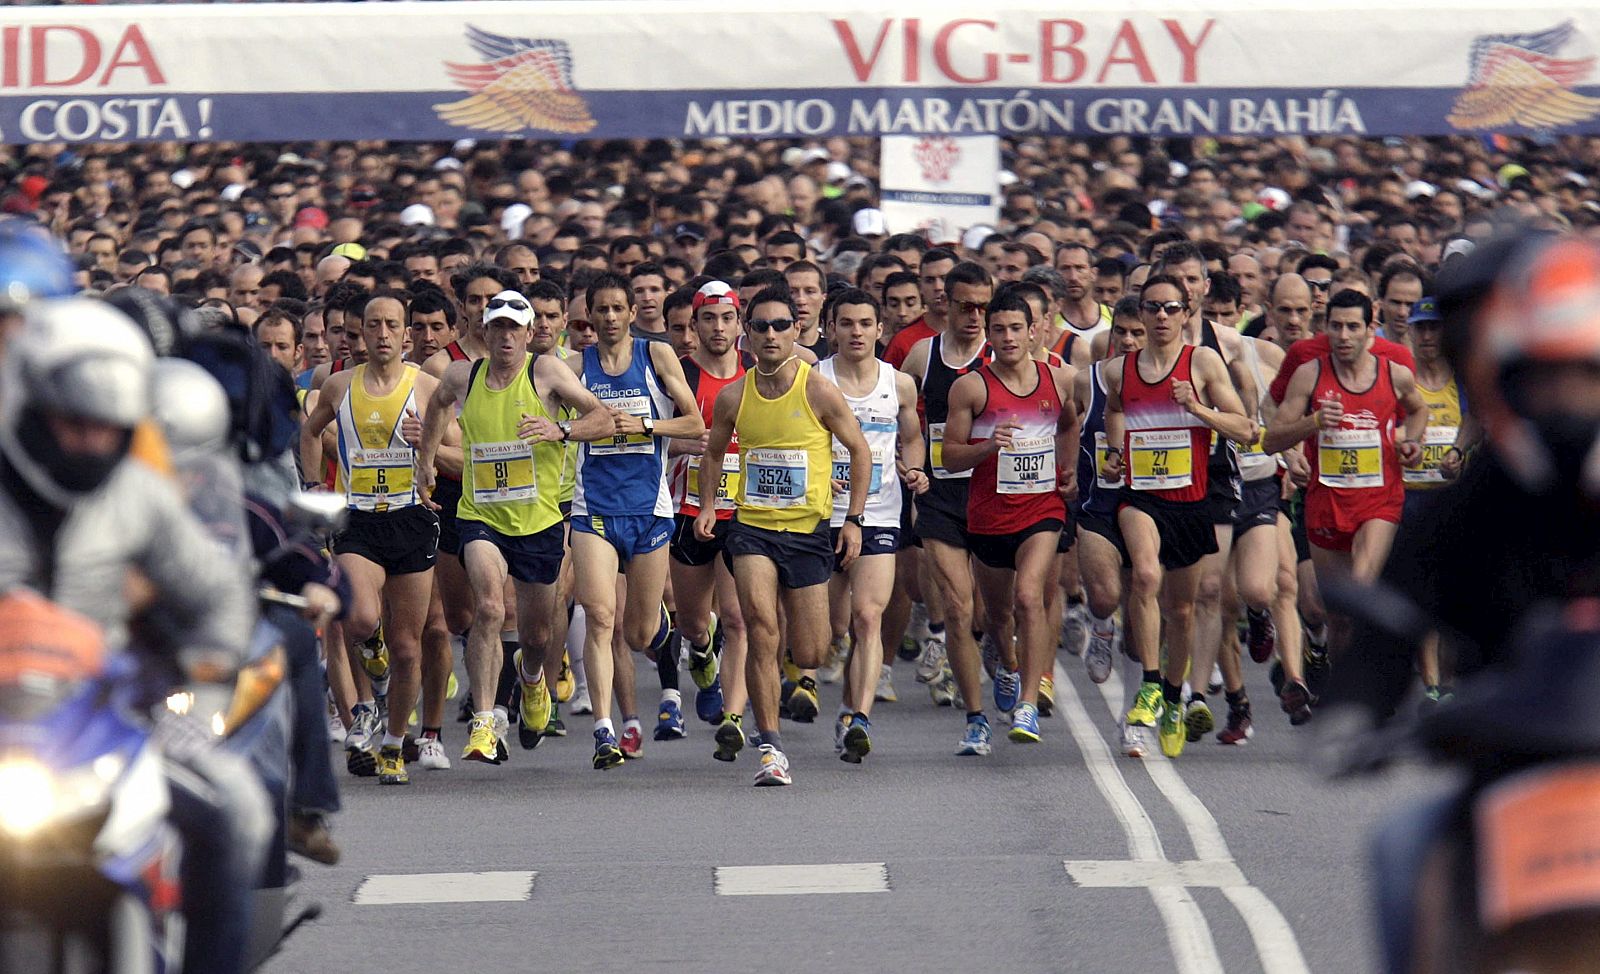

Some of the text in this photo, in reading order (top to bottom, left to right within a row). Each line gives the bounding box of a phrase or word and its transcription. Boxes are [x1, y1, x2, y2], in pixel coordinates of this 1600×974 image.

[831, 18, 1216, 84] VIG-BAY
[684, 90, 1367, 135] MEDIO MARATÓN GRAN BAHÍA
[1014, 454, 1045, 472] 3037
[1152, 451, 1168, 466] 27
[377, 468, 386, 484] 6
[495, 461, 509, 479] 81
[758, 468, 792, 486] 3524
